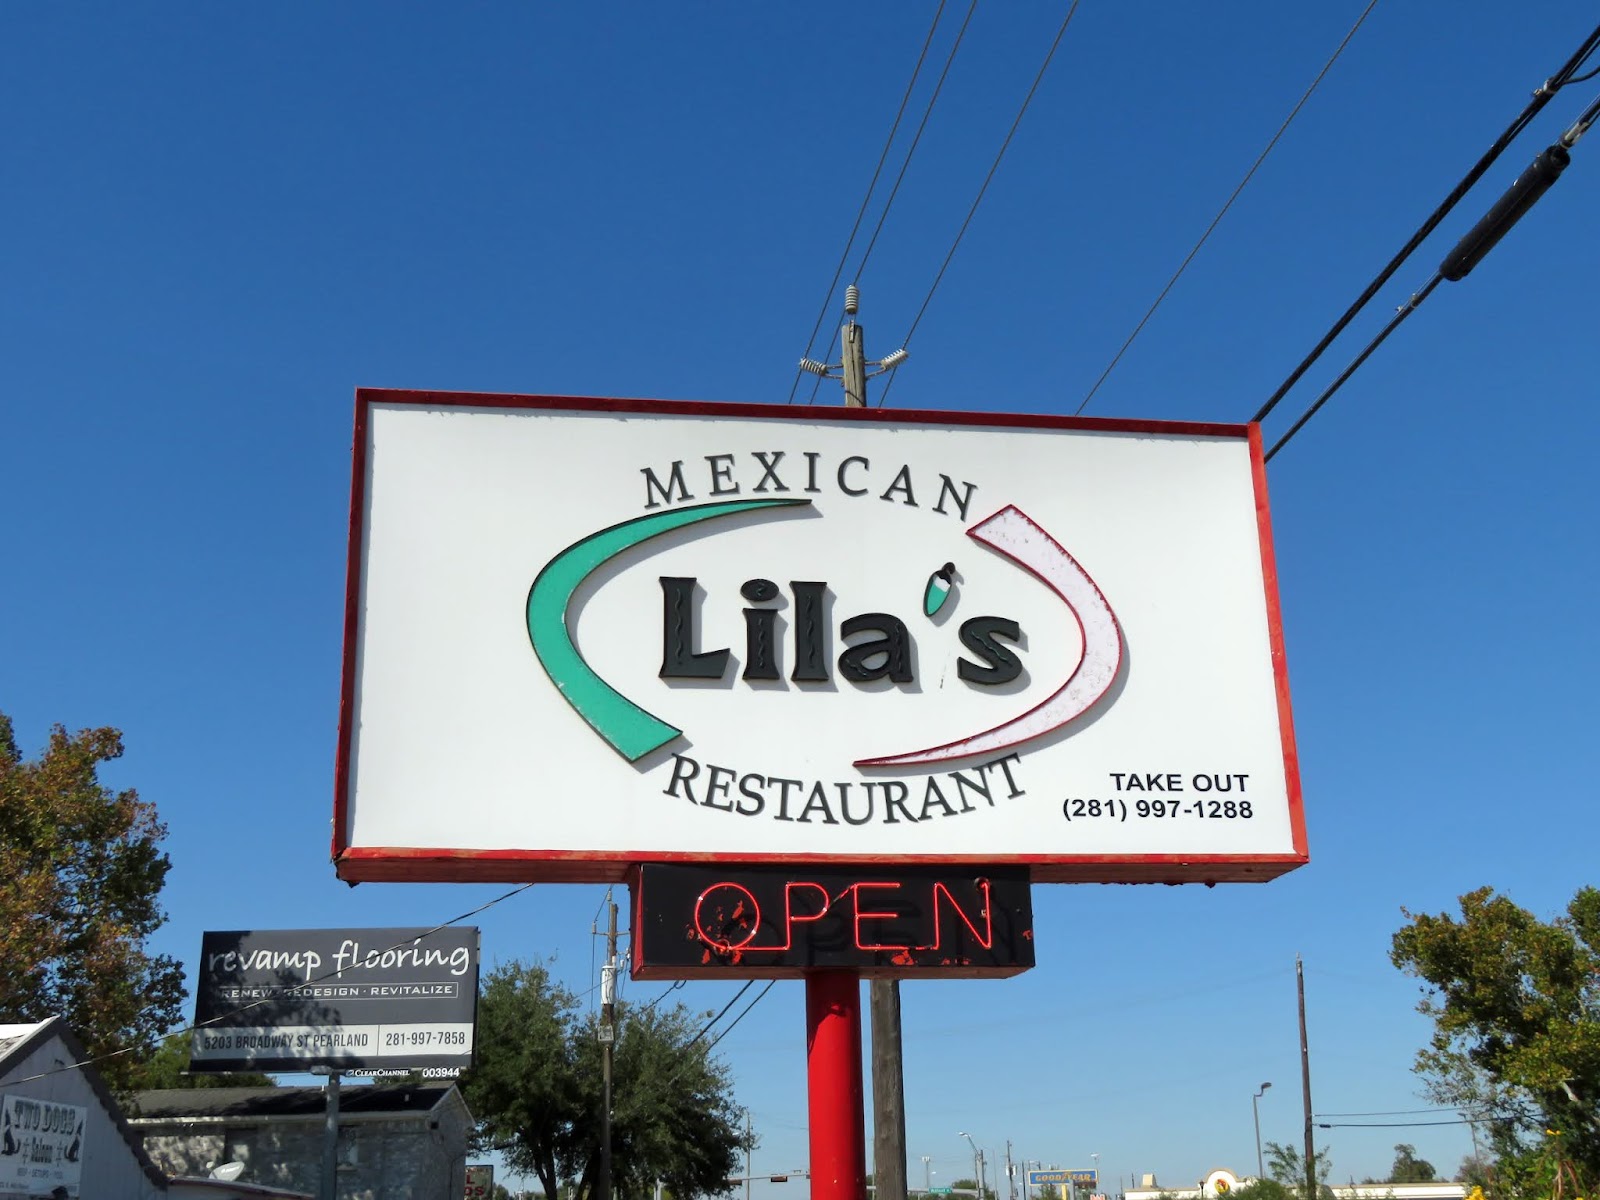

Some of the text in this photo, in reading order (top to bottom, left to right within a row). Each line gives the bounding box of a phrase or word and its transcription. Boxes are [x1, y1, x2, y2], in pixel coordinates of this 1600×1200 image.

[640, 451, 978, 522] MEXICAN
[658, 561, 1023, 686] Lila's
[662, 752, 1026, 826] RESTAURANT
[1109, 773, 1250, 793] TAKE OUT
[1062, 799, 1254, 822] (281) 997-1288
[694, 877, 992, 950] OPEN
[208, 939, 470, 981] revamp flooring
[221, 988, 273, 999] RENEW
[370, 984, 453, 996] REVITALIZE
[204, 1032, 369, 1050] 5203 BROADWAY ST PEARLAND
[385, 1030, 466, 1046] 281-997-7858
[422, 1066, 460, 1078] 003944
[1035, 1172, 1092, 1183] GOODYEAR
